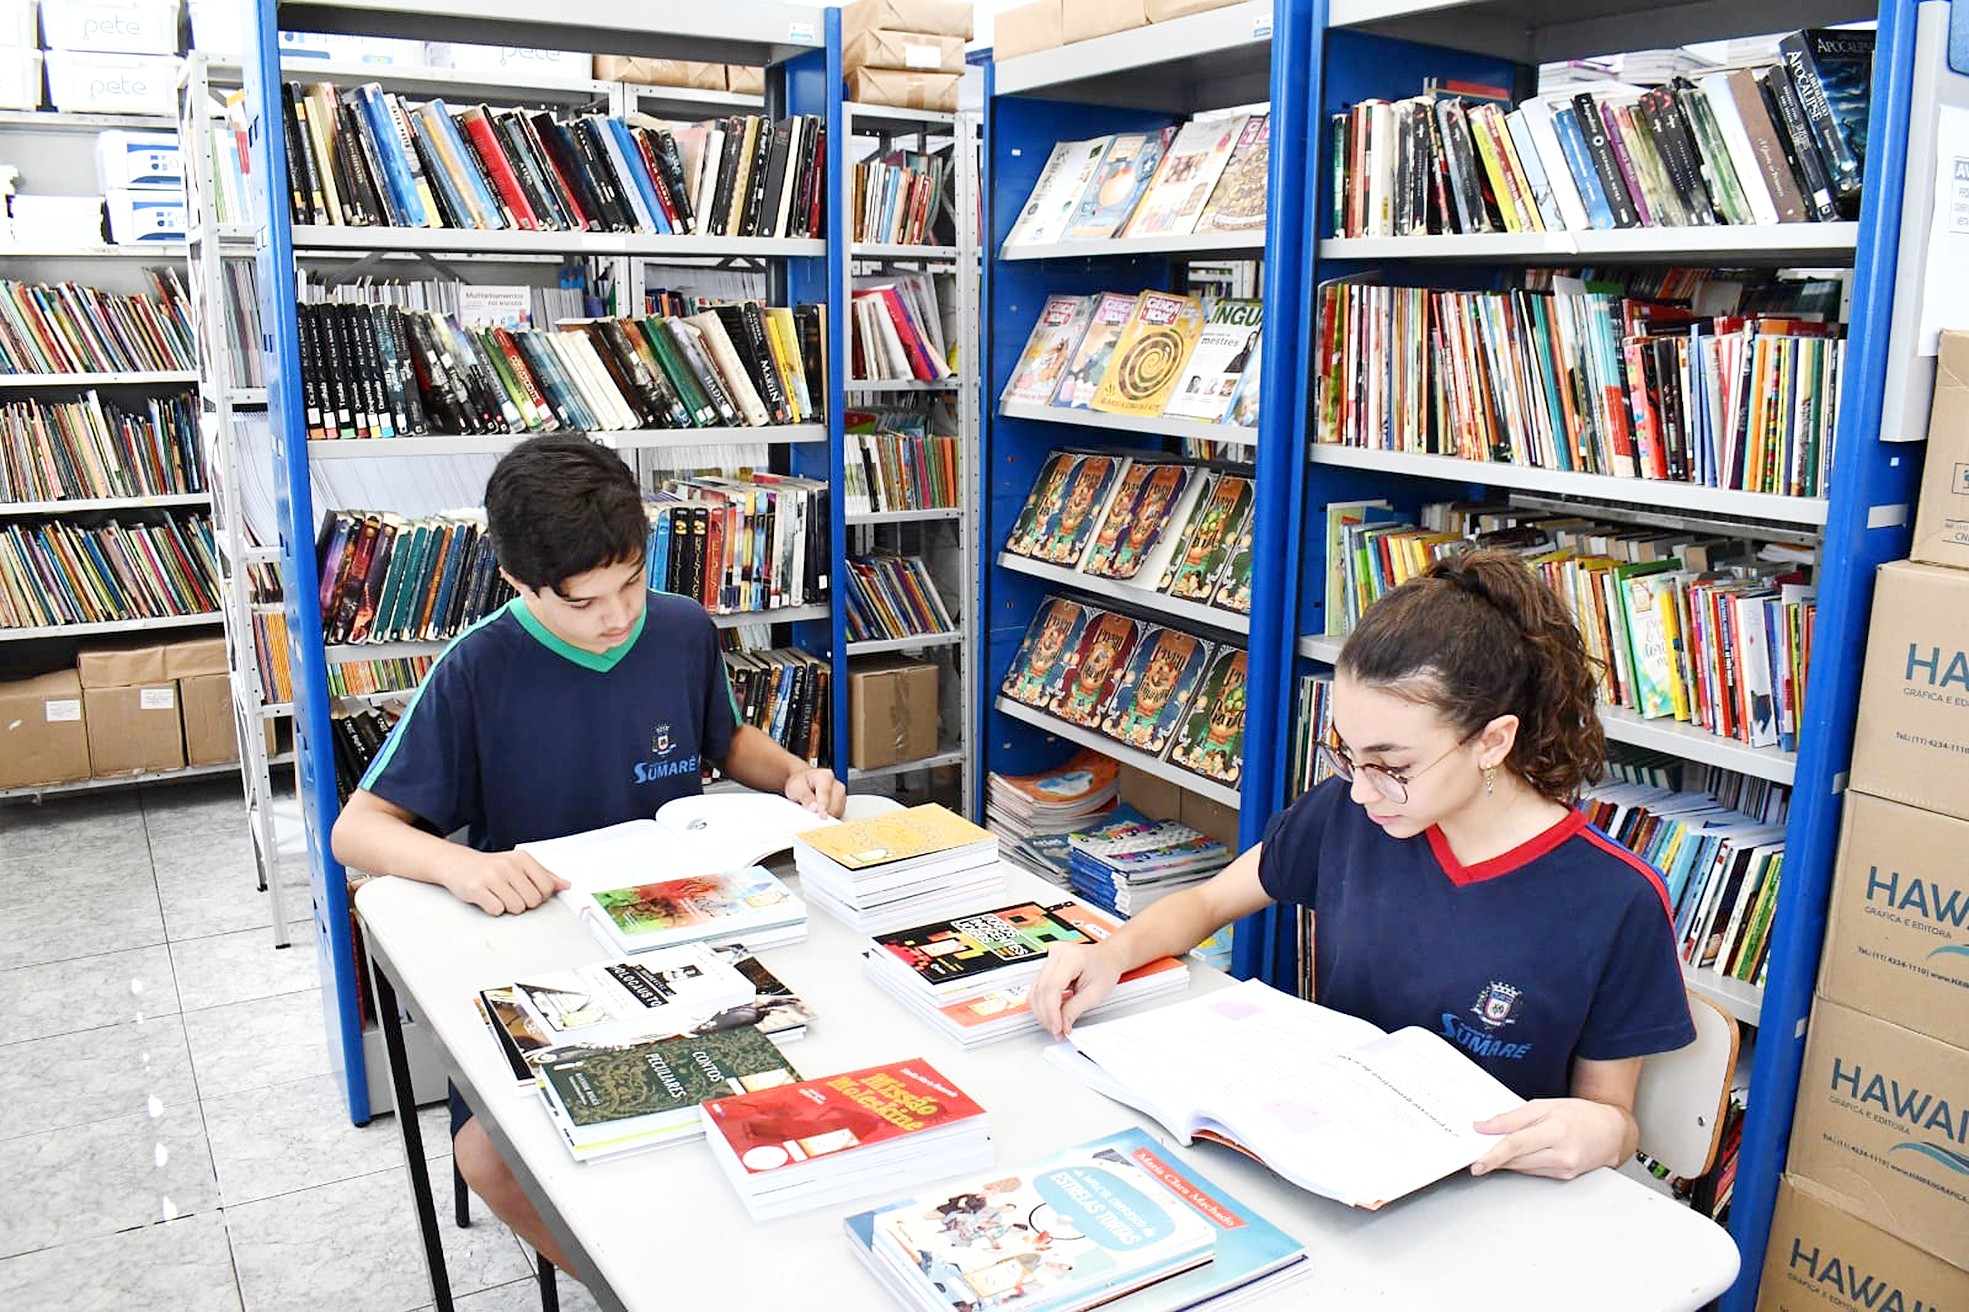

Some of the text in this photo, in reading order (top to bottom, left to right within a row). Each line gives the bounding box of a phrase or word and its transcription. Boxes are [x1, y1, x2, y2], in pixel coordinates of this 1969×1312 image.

[83, 14, 140, 40] pete
[90, 74, 147, 100] pete
[1786, 50, 1823, 122] APOCALIPSE
[1206, 301, 1263, 326] ÍNGU
[1866, 865, 1969, 931] HAW
[1441, 1013, 1533, 1060] SUMARÉ
[645, 1052, 687, 1099] PECULIARES
[692, 1050, 725, 1084] CONTOS
